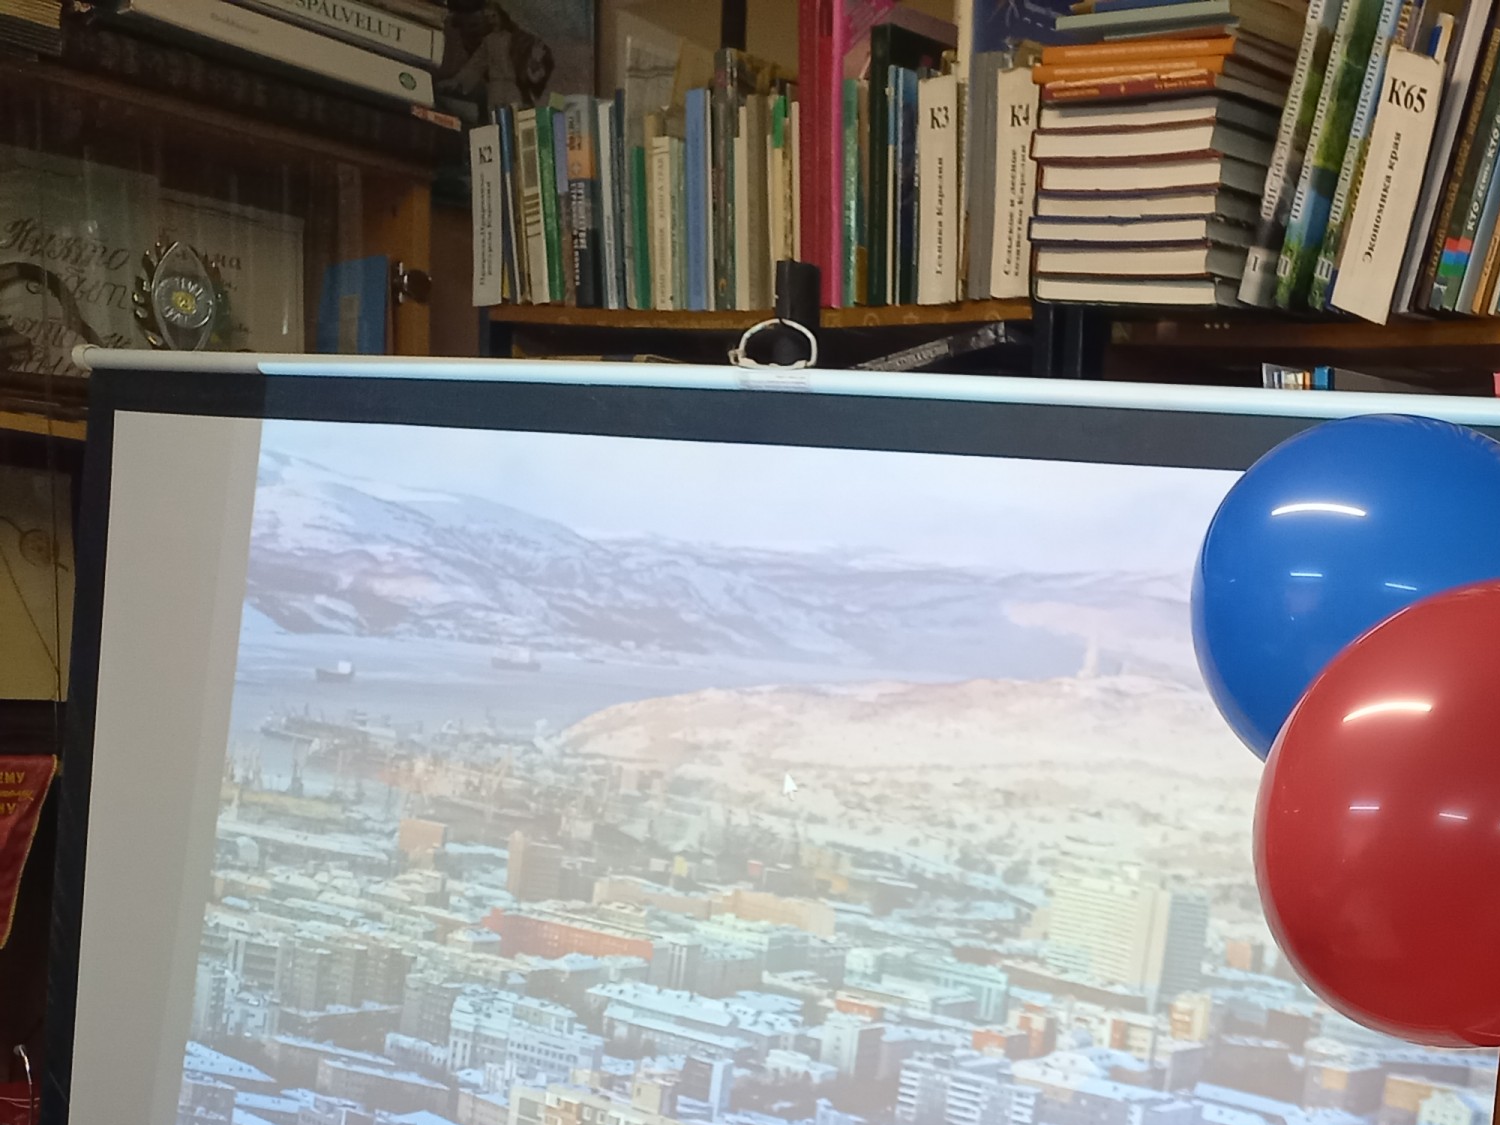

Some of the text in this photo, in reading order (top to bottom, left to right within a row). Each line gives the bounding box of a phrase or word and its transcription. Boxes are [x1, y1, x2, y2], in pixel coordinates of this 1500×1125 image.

[1387, 77, 1428, 113] К65
[1362, 132, 1402, 263] Экономика края
